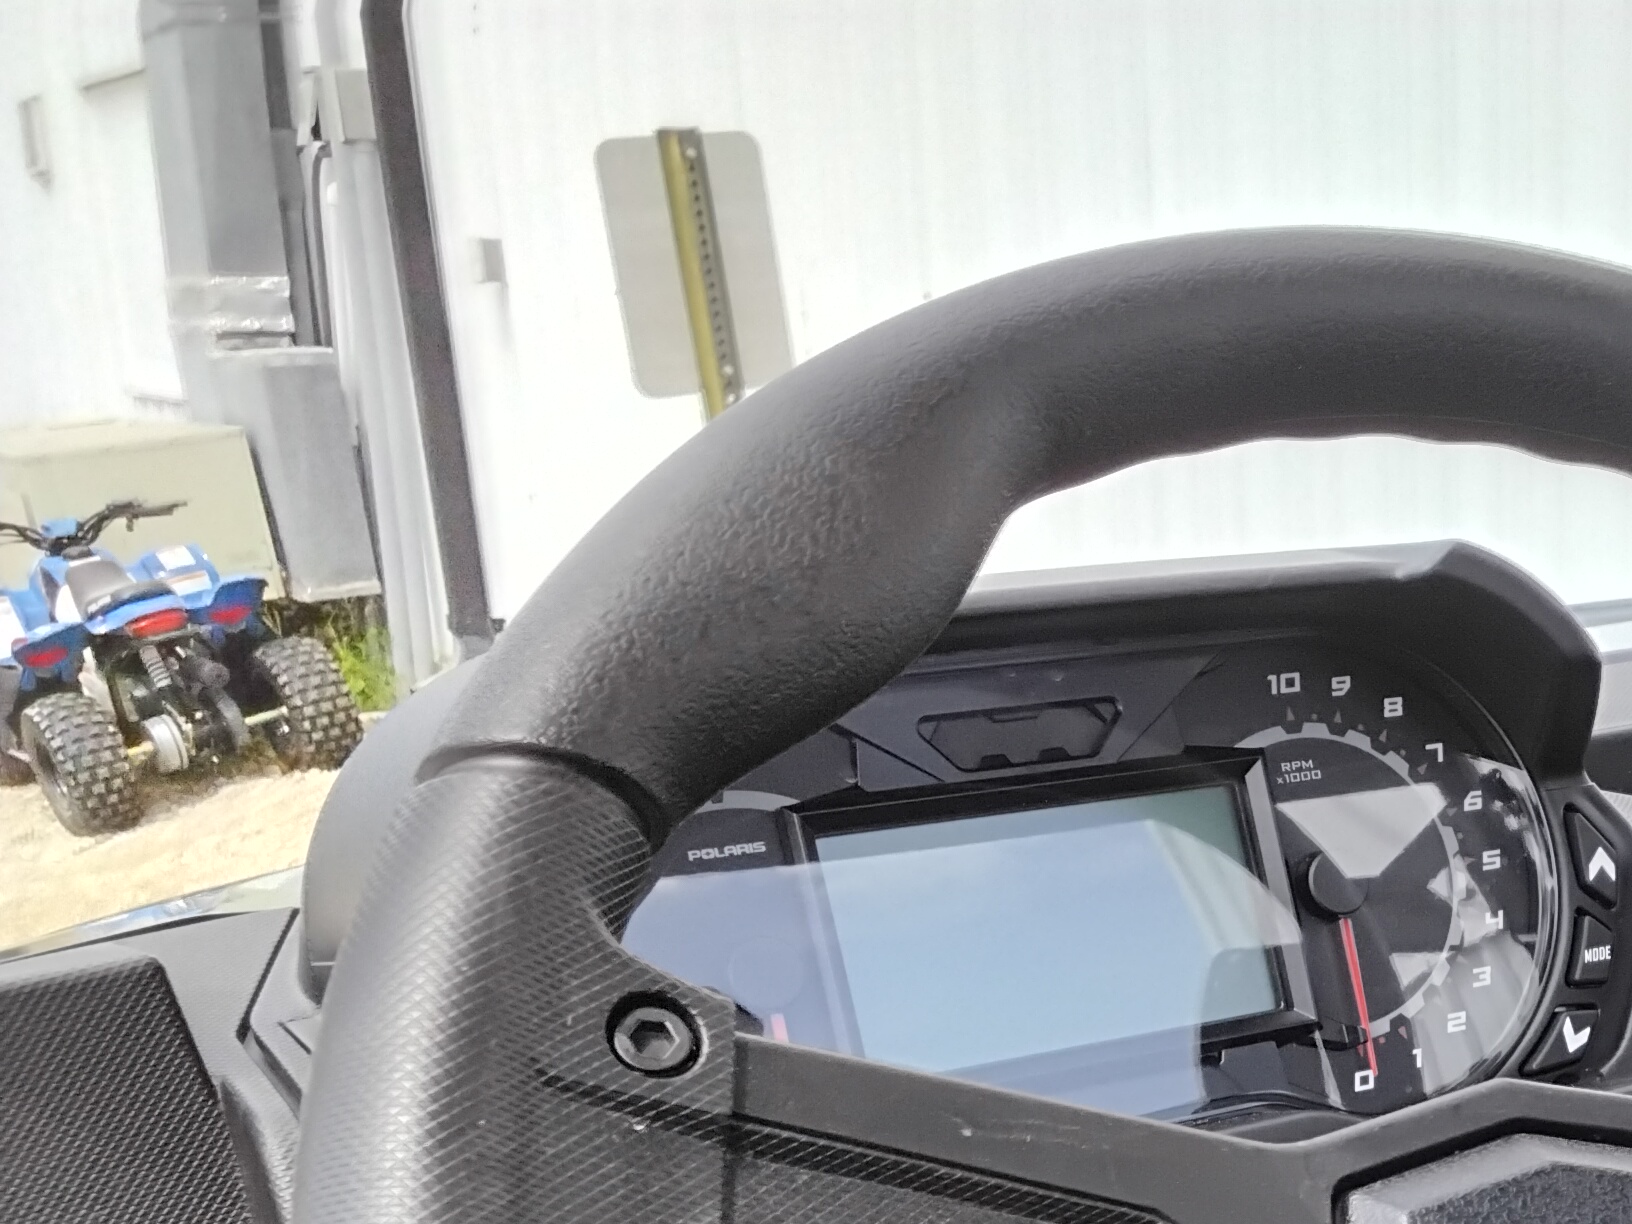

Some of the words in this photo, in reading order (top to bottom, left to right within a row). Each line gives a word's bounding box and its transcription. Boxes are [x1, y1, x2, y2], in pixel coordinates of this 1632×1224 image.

[1267, 671, 1301, 695] 10
[1331, 675, 1351, 697] 9
[1383, 696, 1403, 718] 8
[1425, 742, 1444, 763] 7
[1276, 769, 1322, 785] x1000
[1281, 759, 1314, 773] RPM
[1463, 790, 1483, 812] 6
[687, 841, 767, 862] POLARIS
[1482, 849, 1501, 871] 5
[1485, 909, 1504, 930] 4
[1584, 945, 1612, 964] MODE
[1472, 965, 1491, 988] 3
[1447, 1010, 1466, 1033] 2
[1412, 1047, 1423, 1069] 1
[1354, 1069, 1375, 1093] 0
